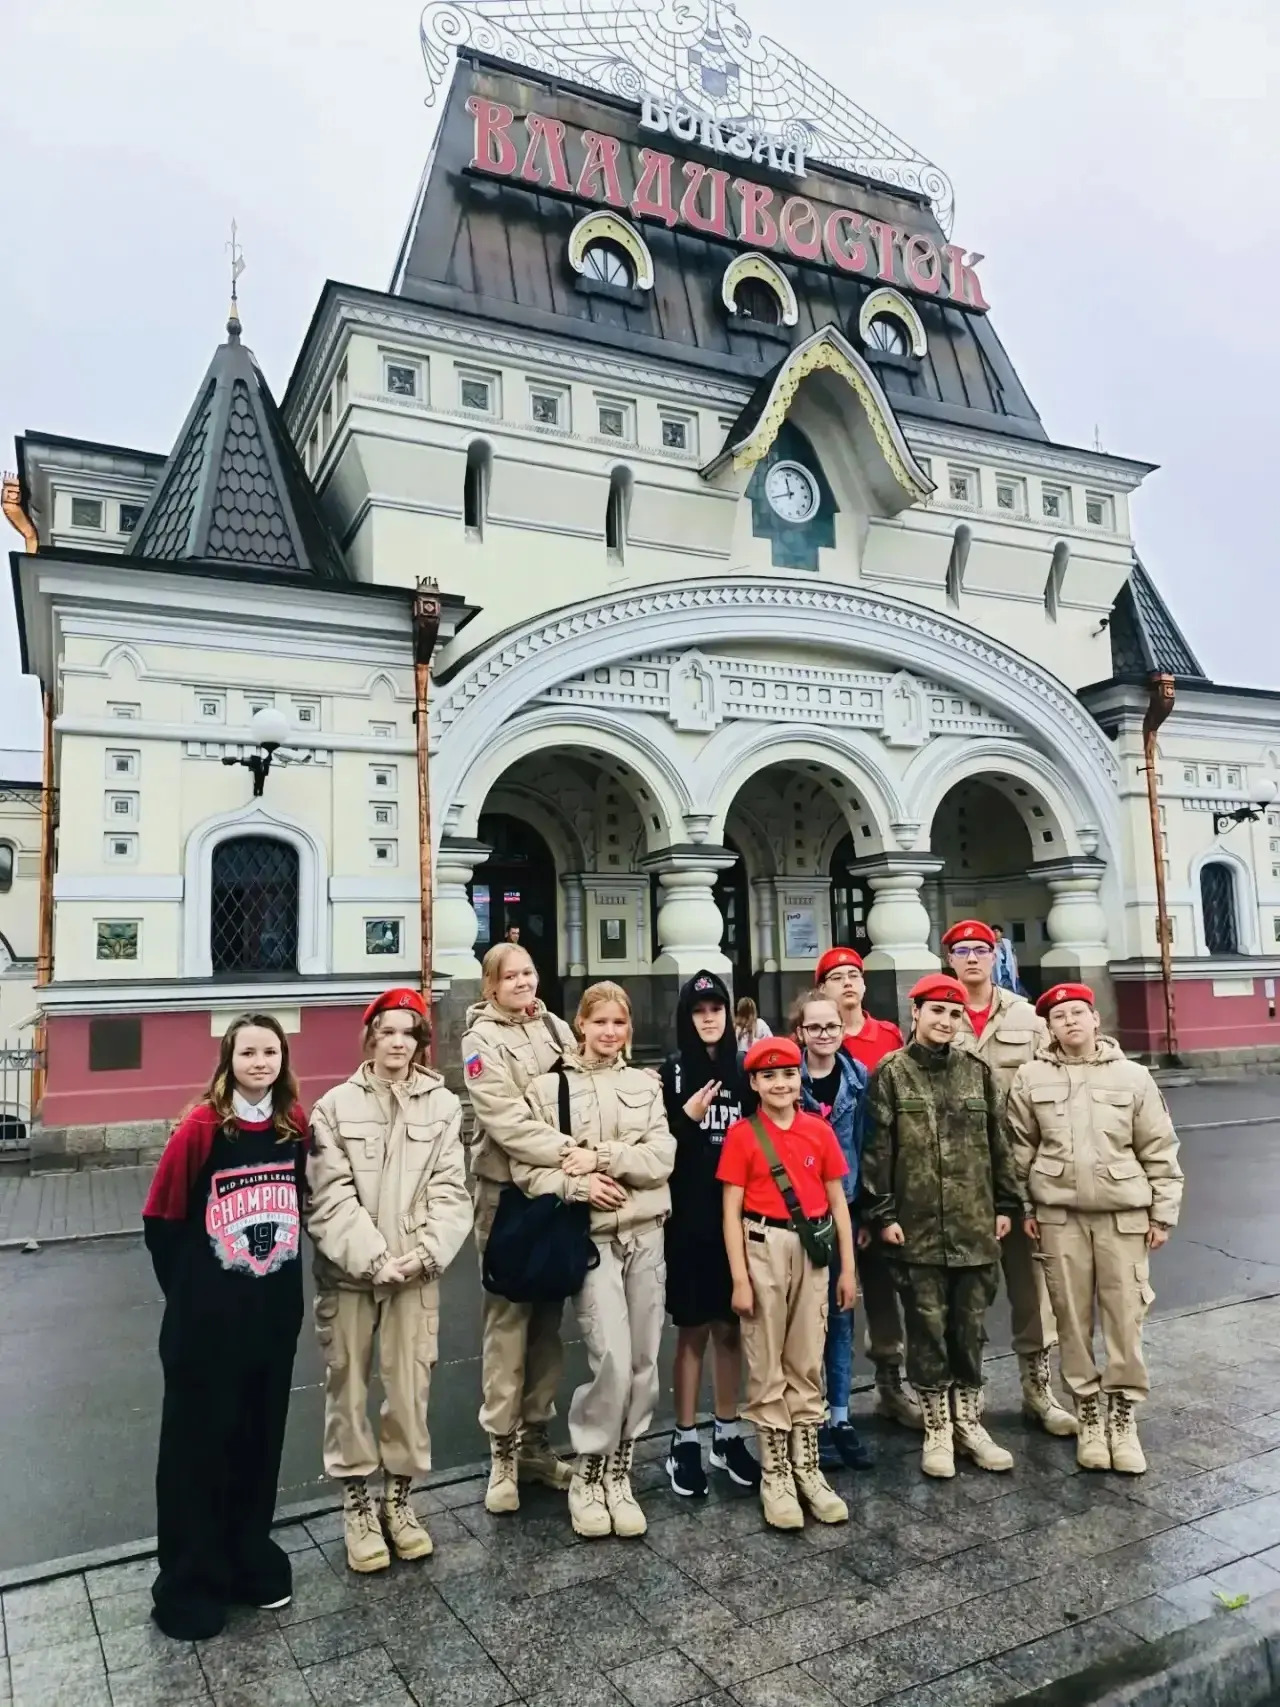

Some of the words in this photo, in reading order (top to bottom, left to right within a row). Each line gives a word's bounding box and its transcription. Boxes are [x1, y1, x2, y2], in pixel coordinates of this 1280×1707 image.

[638, 90, 807, 178] ВОКЗАЛ
[465, 95, 991, 312] ВЛАДИВОСТОК
[220, 1182, 236, 1193] MID
[240, 1174, 267, 1185] PLAINS
